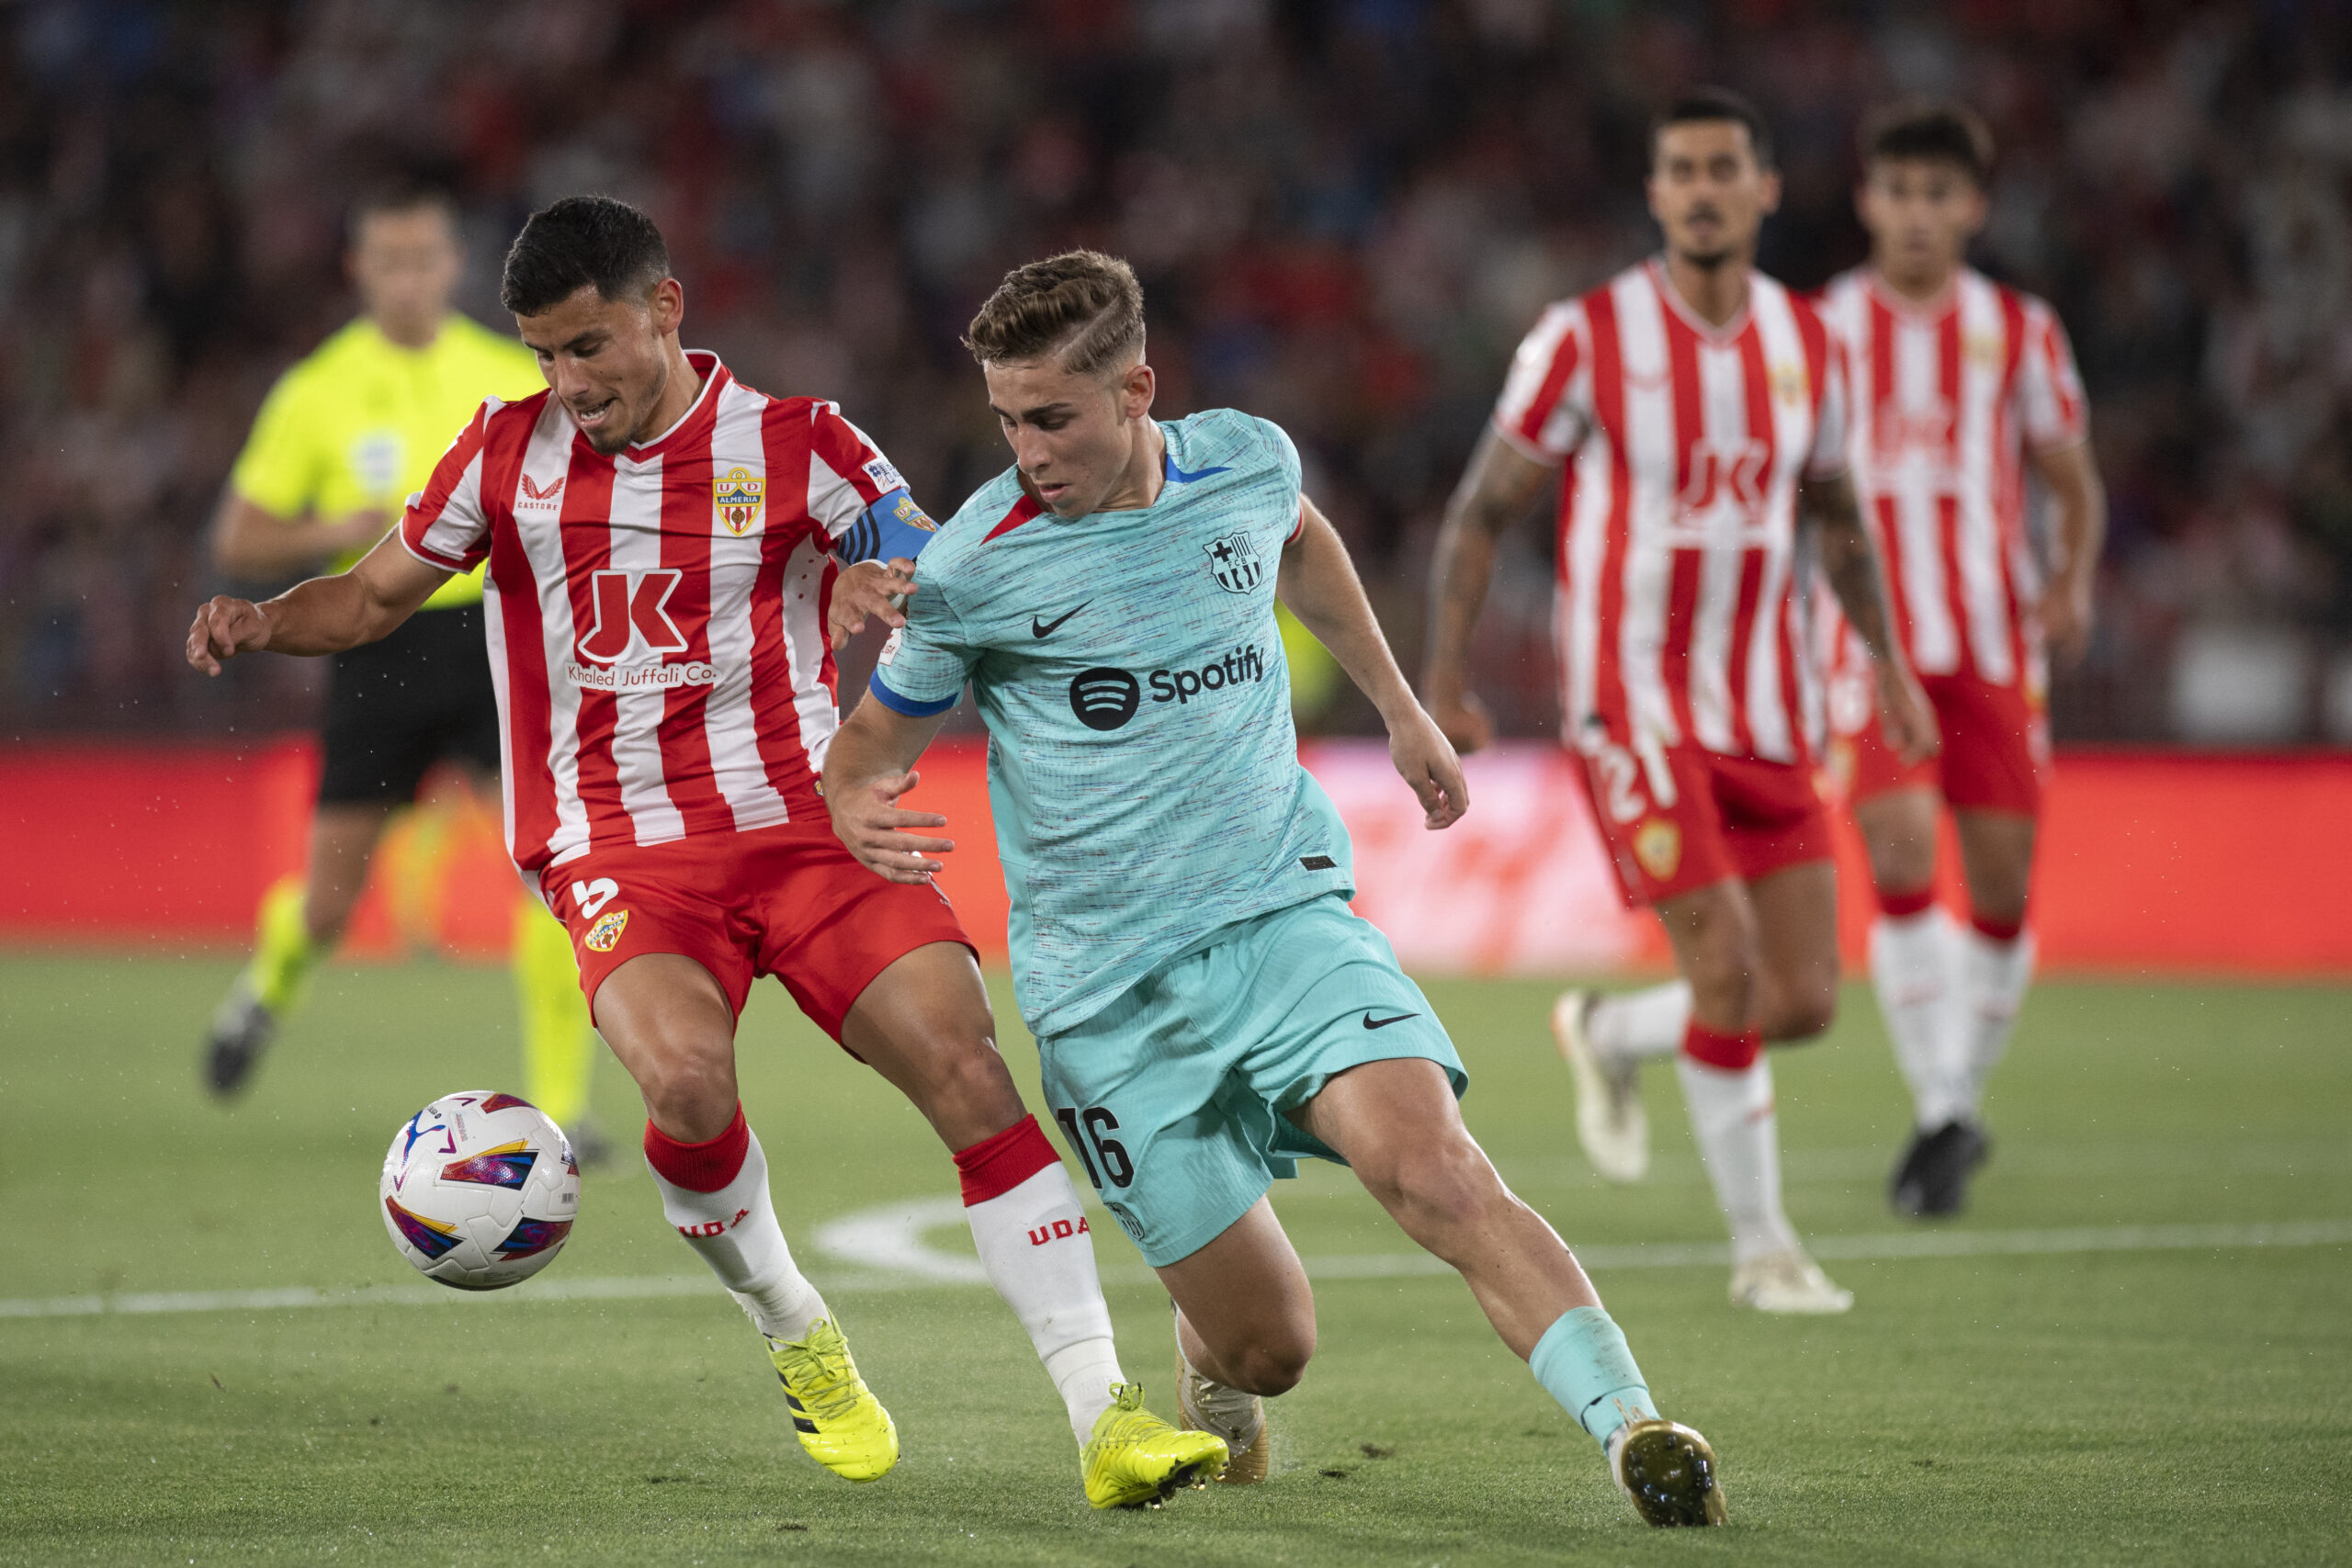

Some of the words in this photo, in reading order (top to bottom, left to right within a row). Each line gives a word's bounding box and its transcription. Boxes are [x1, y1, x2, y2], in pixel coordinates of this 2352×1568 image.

[719, 496, 758, 504] ALMERIA
[720, 483, 730, 492] U
[747, 483, 758, 491] D
[517, 501, 559, 511] CASTORE
[1227, 558, 1248, 569] FCB
[580, 570, 686, 660] JK
[567, 665, 616, 686] Khaled
[622, 668, 680, 686] Juffali
[685, 664, 718, 681] Co.
[1148, 644, 1264, 704] Spotify
[571, 877, 619, 919] 5
[1057, 1105, 1135, 1190] 16
[678, 1208, 750, 1238] UDA
[1027, 1216, 1091, 1247] UDA
